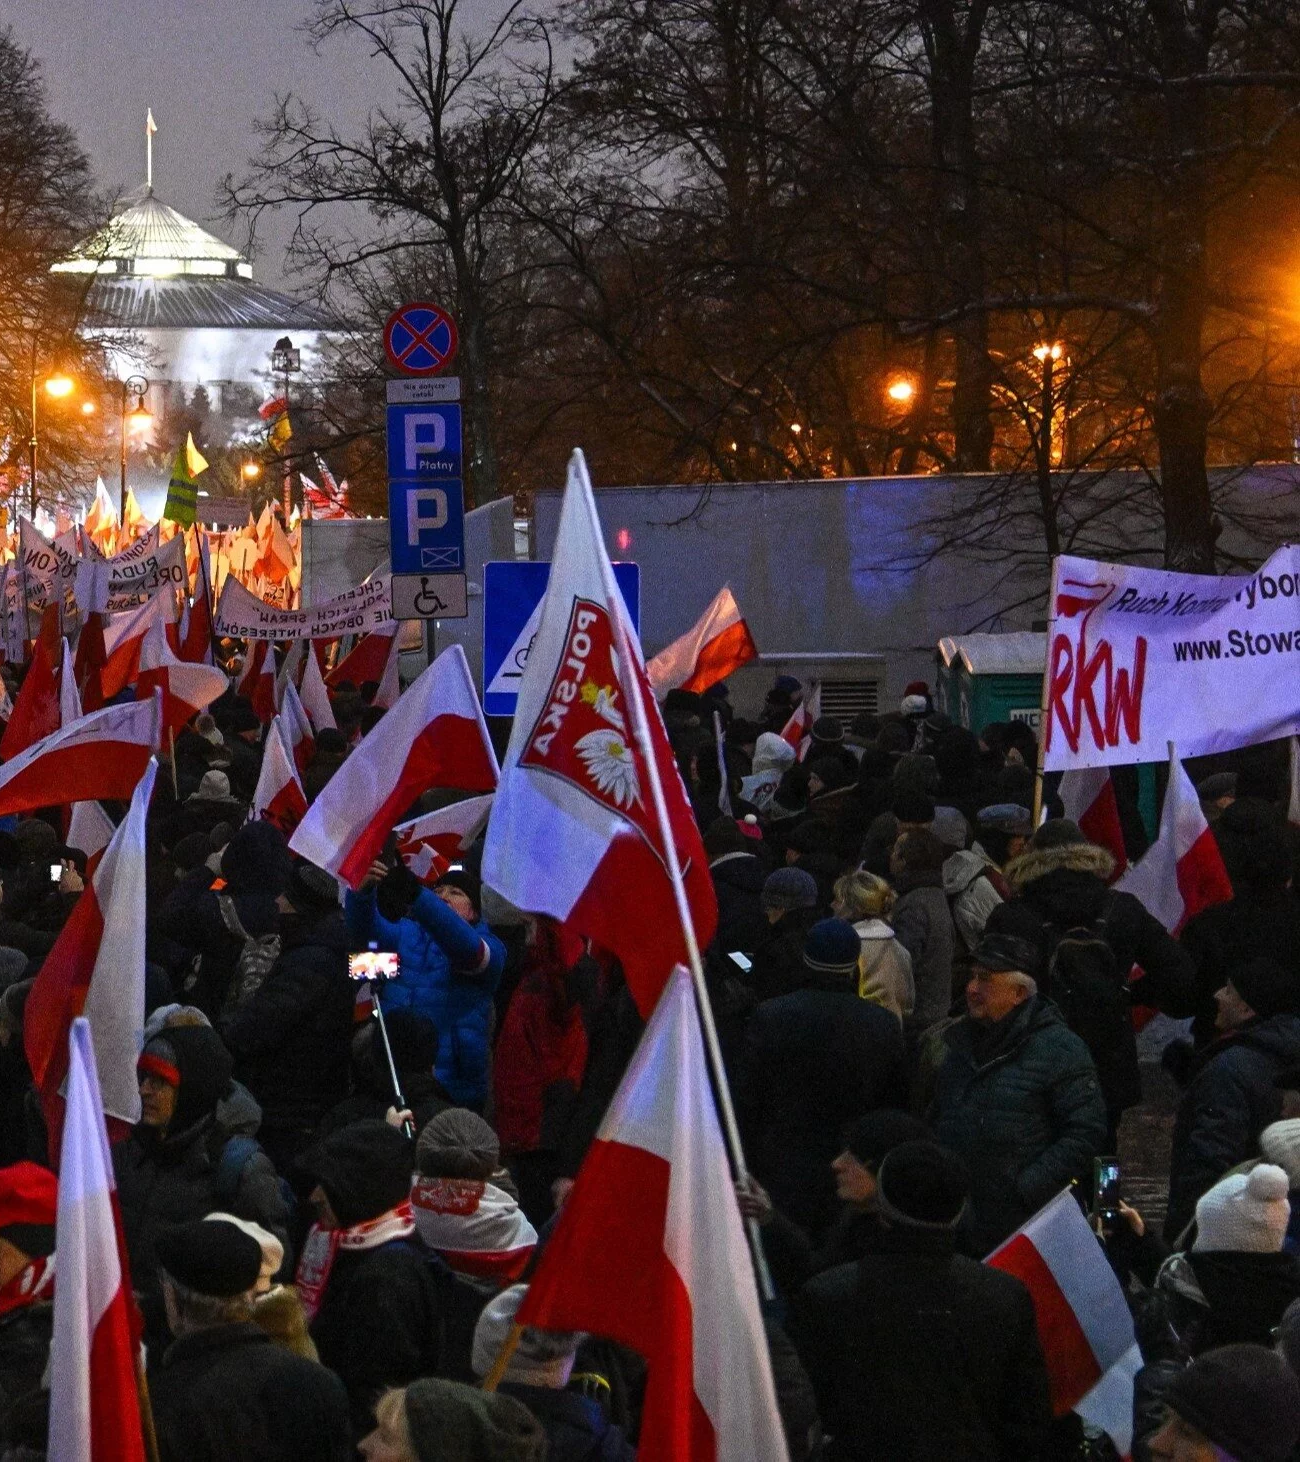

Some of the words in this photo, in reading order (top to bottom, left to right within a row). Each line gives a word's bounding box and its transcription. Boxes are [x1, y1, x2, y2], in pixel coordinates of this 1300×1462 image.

[405, 413, 446, 470] P
[419, 460, 454, 472] Płatny
[406, 488, 448, 546] P
[1108, 587, 1168, 614] Ruch
[1046, 630, 1147, 755] RKW
